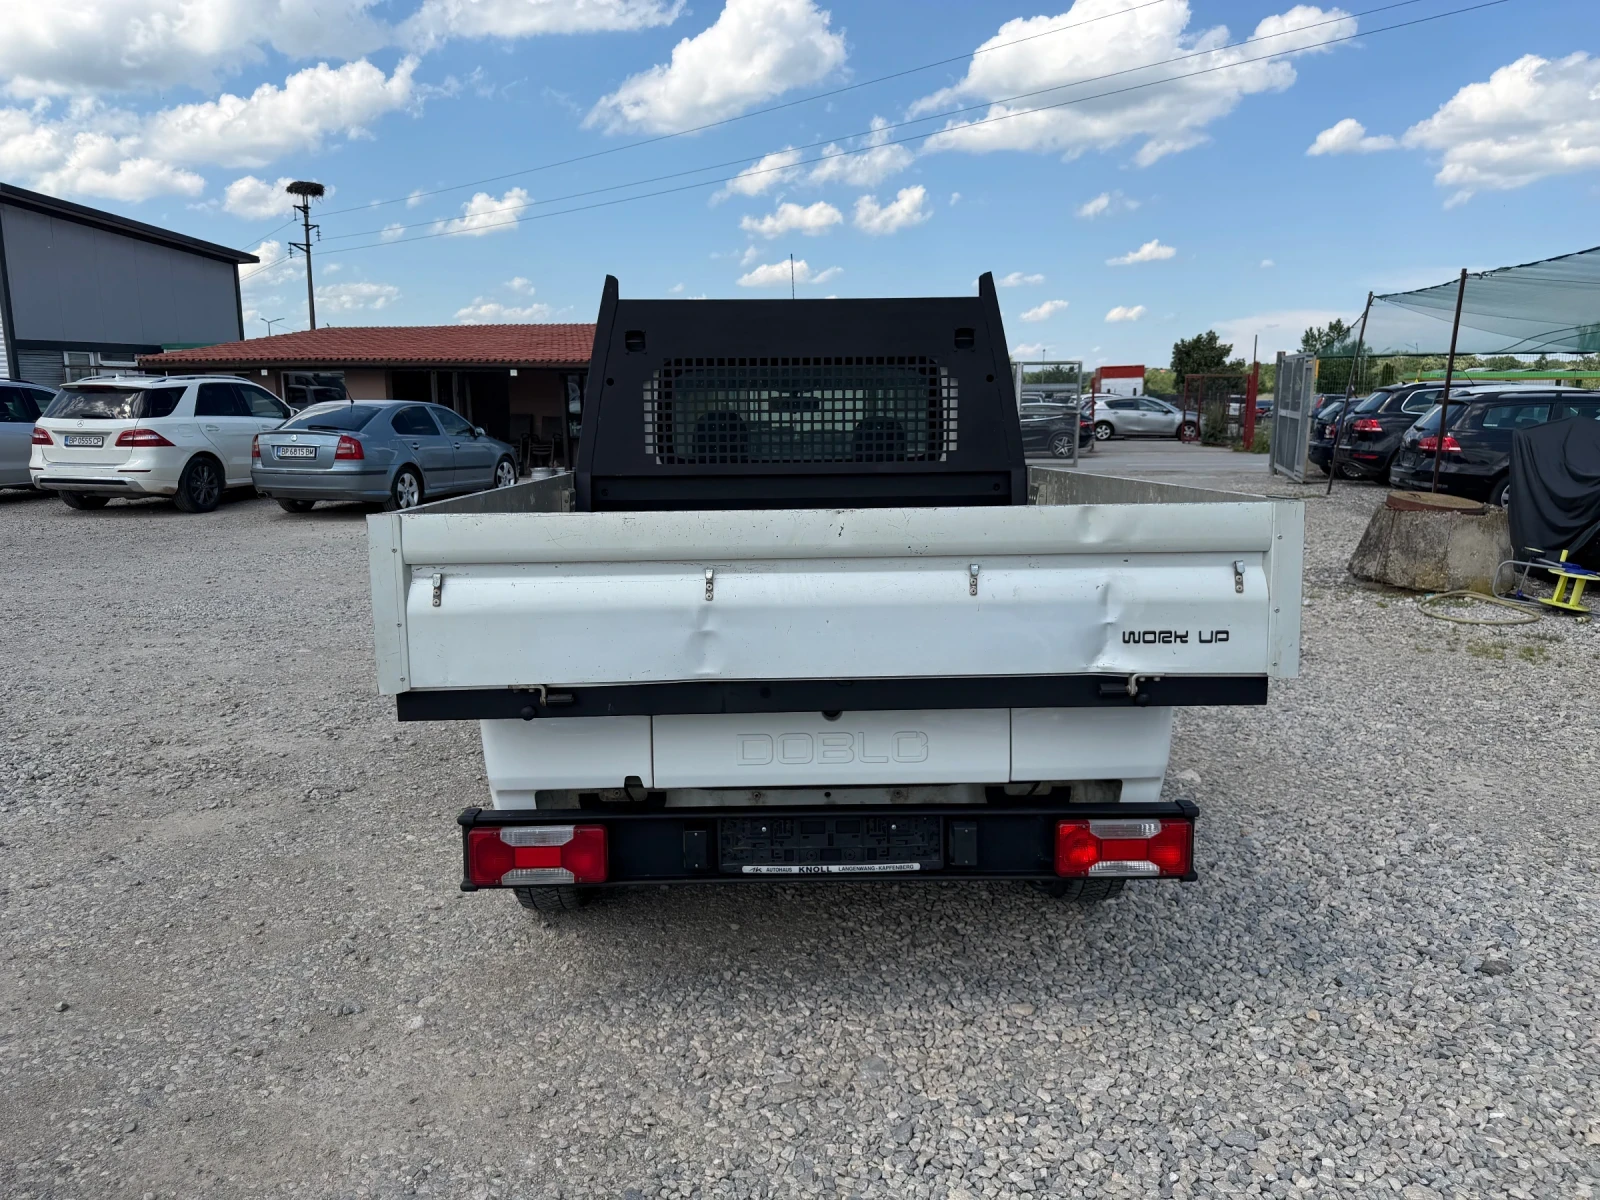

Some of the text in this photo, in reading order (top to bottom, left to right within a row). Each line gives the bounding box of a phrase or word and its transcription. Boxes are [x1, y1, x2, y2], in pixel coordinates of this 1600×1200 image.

[290, 447, 305, 456] 6815
[1122, 630, 1230, 644] WORK UP
